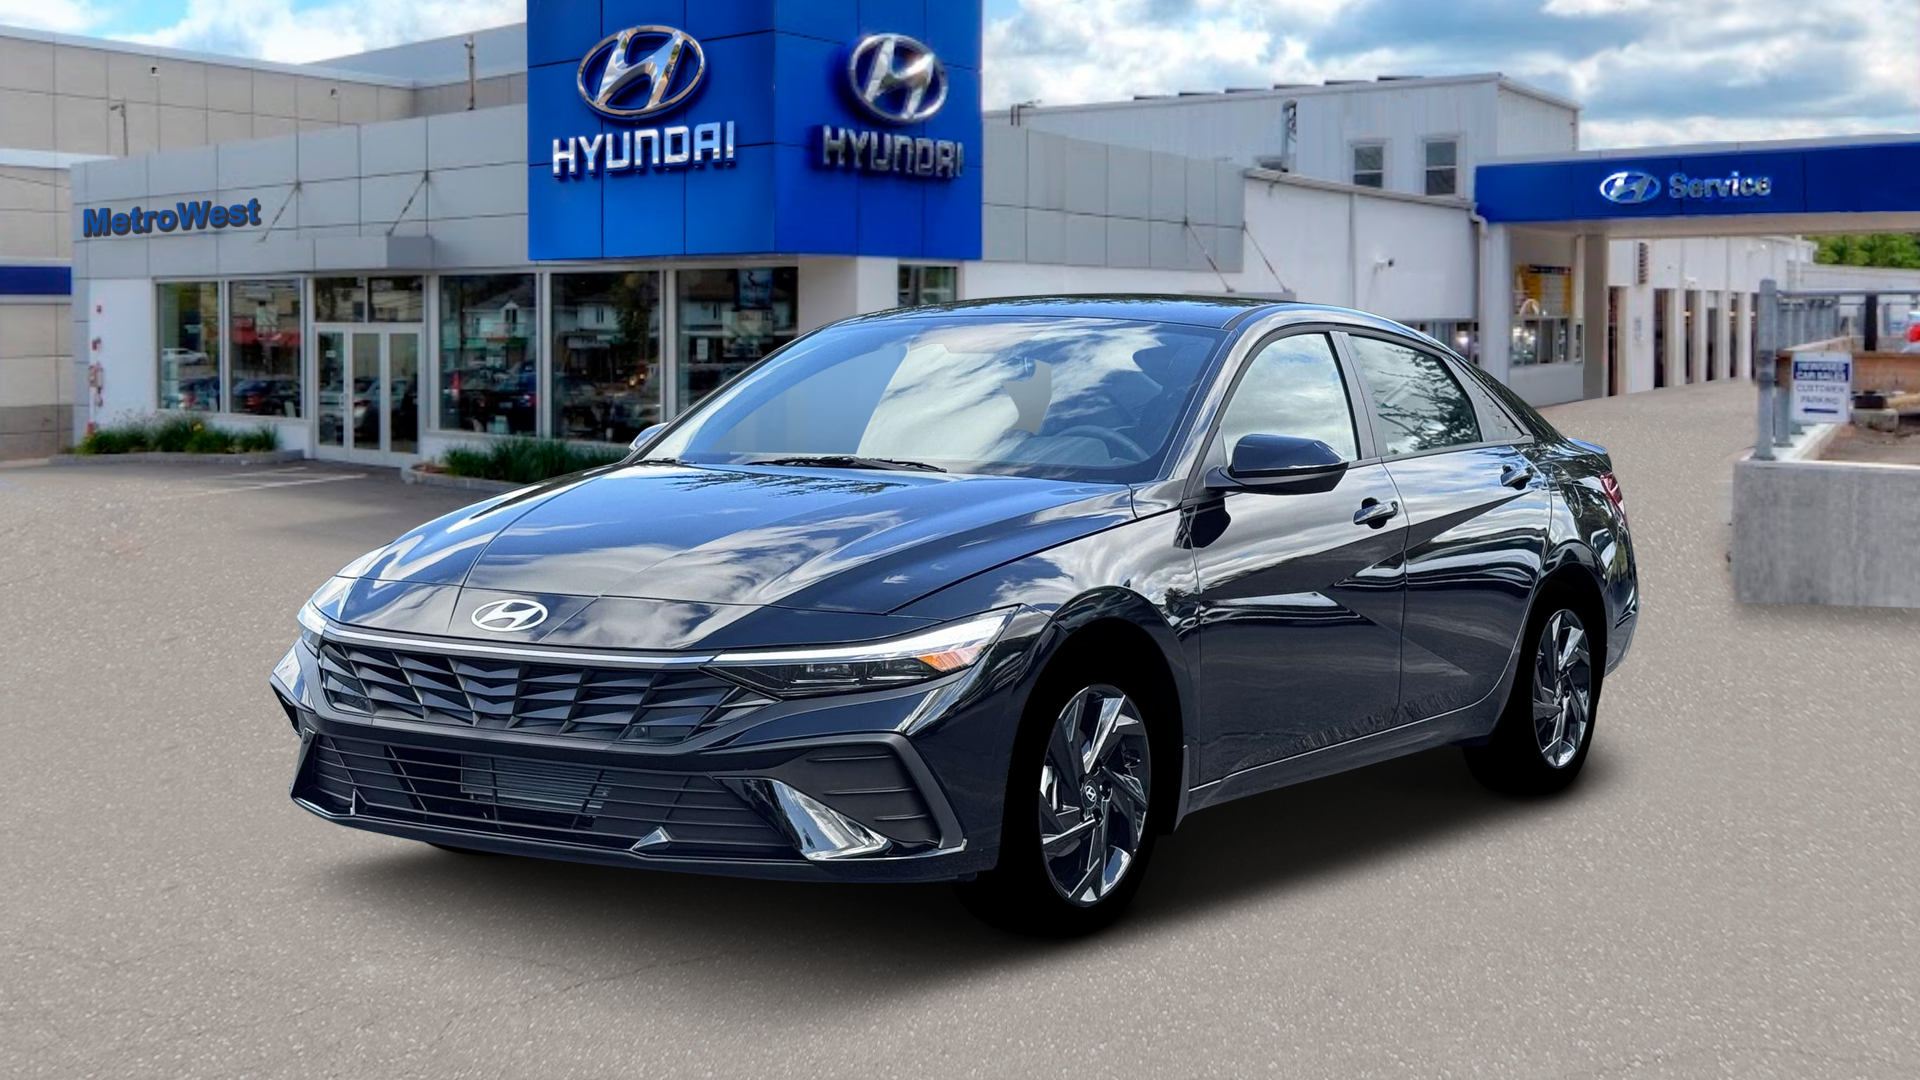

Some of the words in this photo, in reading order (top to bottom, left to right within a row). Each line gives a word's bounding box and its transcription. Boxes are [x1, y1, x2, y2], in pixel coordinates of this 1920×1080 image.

[552, 120, 735, 176] HYUNDAI
[822, 124, 964, 178] HYUNDAI
[1668, 171, 1772, 199] Service
[83, 198, 262, 238] MetroWest
